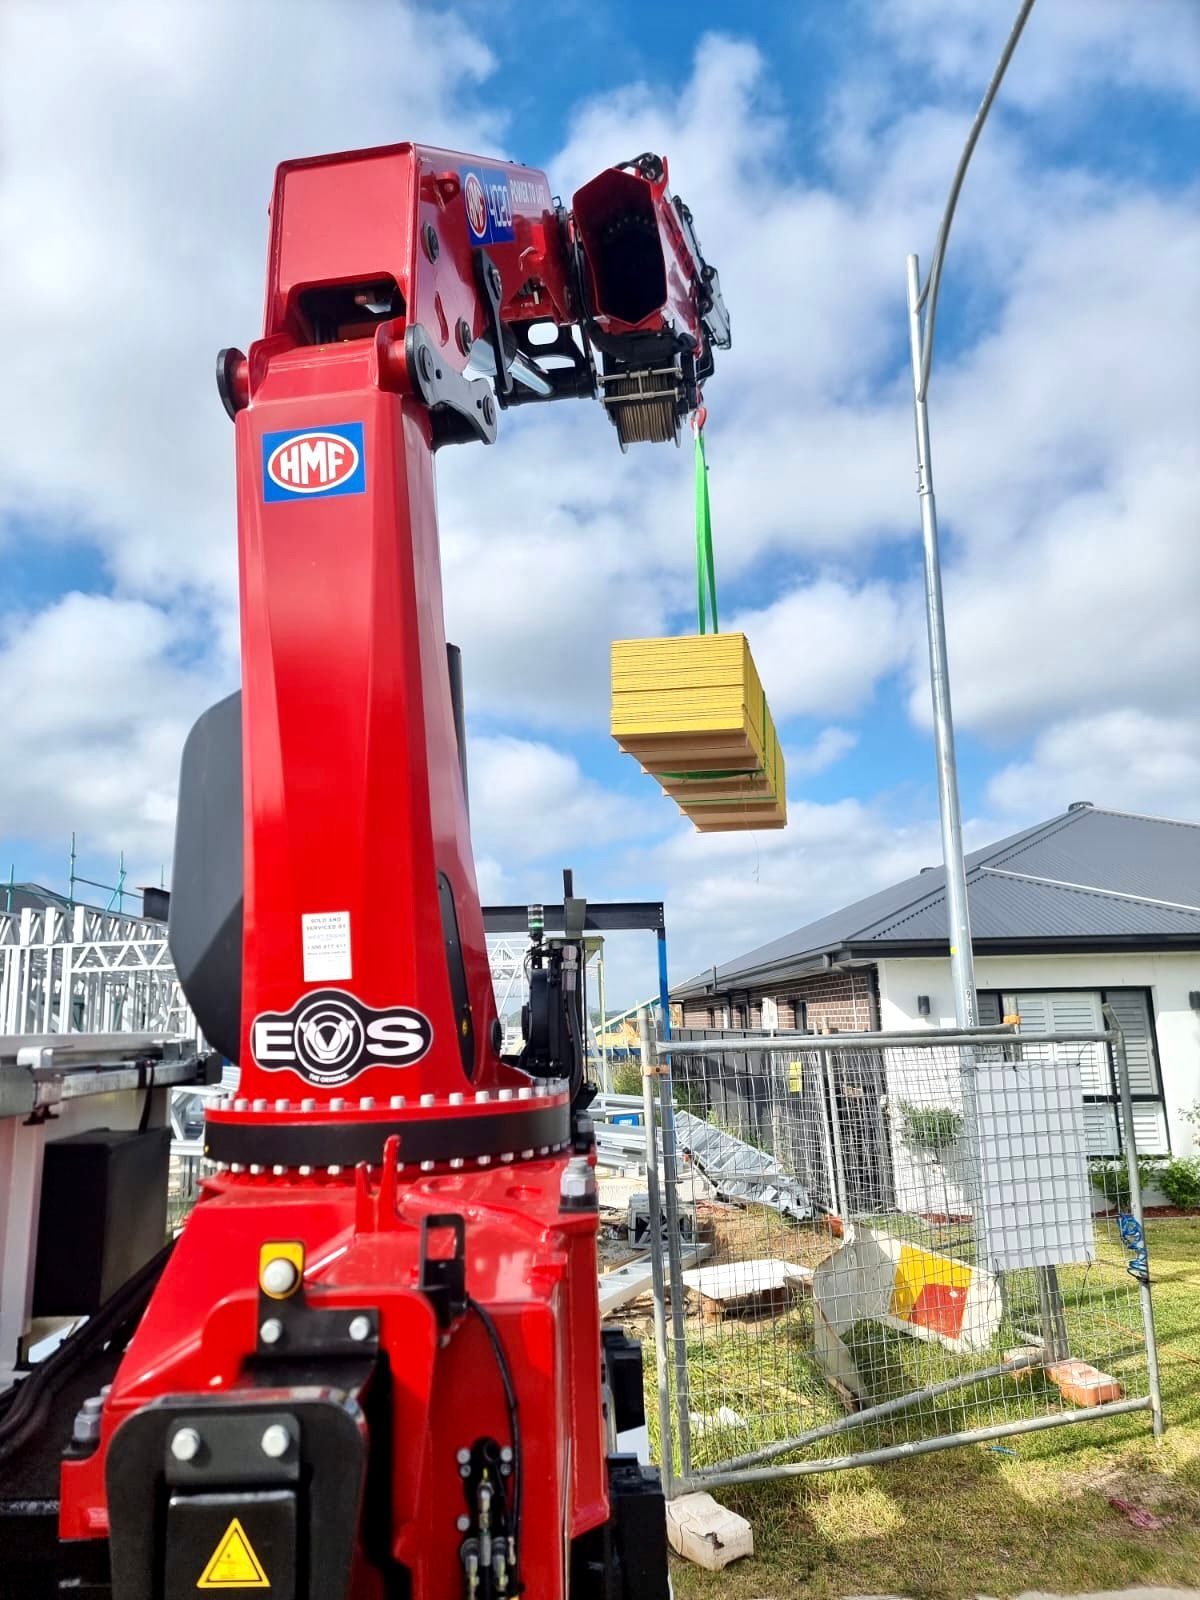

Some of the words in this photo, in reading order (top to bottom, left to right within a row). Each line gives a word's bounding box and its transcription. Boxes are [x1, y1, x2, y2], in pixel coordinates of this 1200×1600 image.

[466, 181, 484, 230] HMF
[485, 184, 512, 228] 4020
[280, 440, 345, 485] HMF
[309, 1073, 320, 1082] THE
[320, 1072, 349, 1083] ORIGINAL
